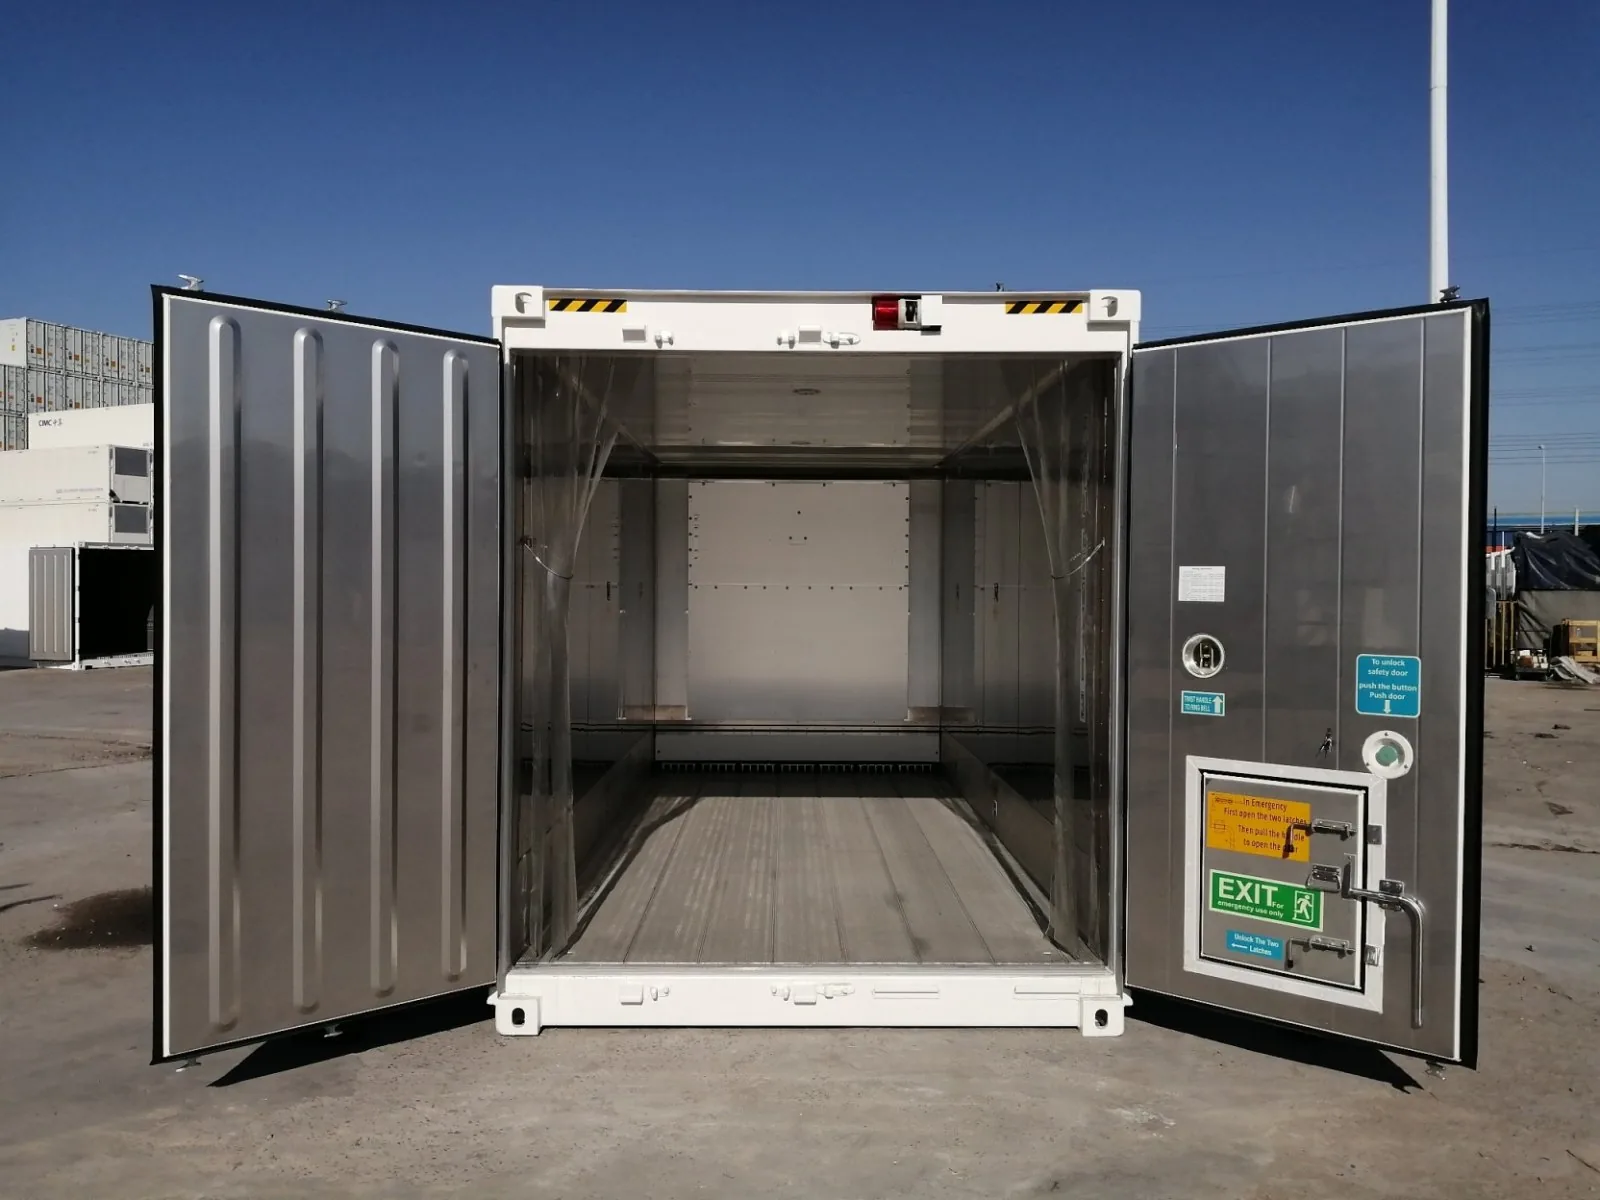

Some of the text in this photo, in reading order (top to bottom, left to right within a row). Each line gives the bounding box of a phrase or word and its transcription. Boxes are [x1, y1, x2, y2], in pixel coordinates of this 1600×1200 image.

[1368, 668, 1389, 676] safety
[1359, 682, 1376, 690] push
[1391, 683, 1417, 691] button
[1251, 799, 1288, 812] Emergency
[1224, 807, 1238, 817] First
[1239, 811, 1255, 819] open
[1257, 811, 1268, 820] the
[1269, 814, 1281, 822] two
[1238, 824, 1305, 842] Then pull the hdle
[1243, 838, 1250, 846] to
[1252, 840, 1268, 848] open
[1270, 842, 1280, 851] the
[1219, 877, 1278, 907] EXIT
[1218, 900, 1254, 913] emergency
[1268, 910, 1284, 918] only
[1272, 901, 1284, 909] For
[1255, 936, 1266, 945] The
[1267, 939, 1279, 948] Two
[1249, 945, 1272, 956] Latches
